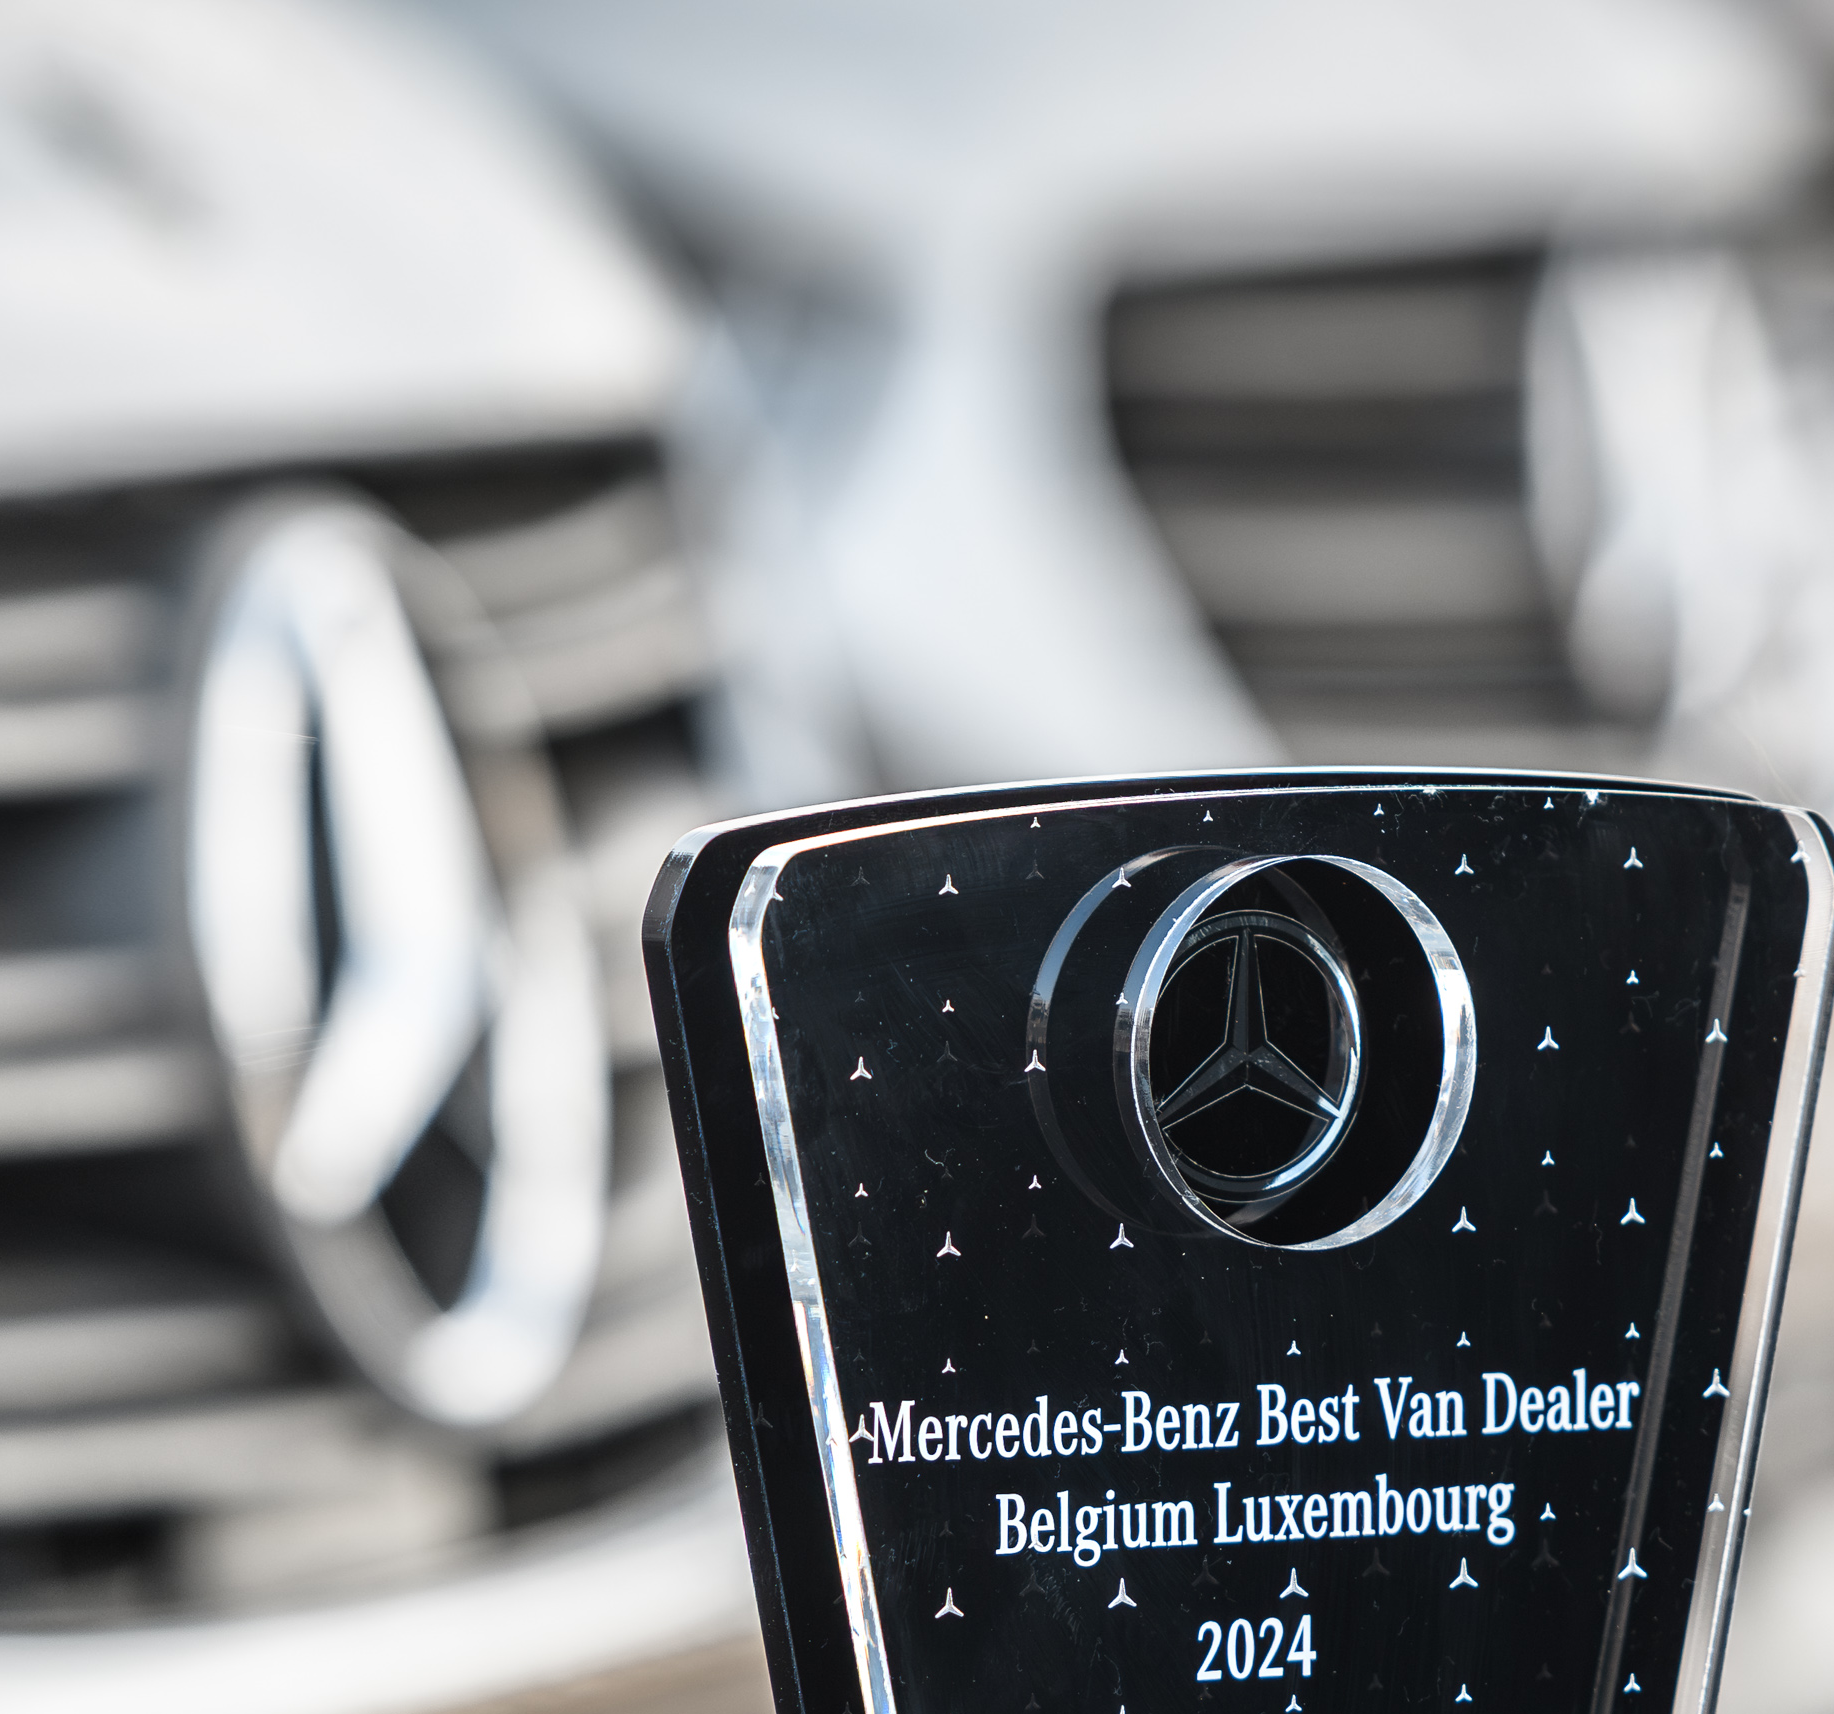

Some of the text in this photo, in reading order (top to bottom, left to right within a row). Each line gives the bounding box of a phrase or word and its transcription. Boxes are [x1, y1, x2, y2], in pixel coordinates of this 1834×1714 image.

[868, 1368, 1640, 1464] Mercedes-Benz Best Van Dealer
[995, 1474, 1515, 1567] Belgium Luxembourg
[1196, 1614, 1317, 1681] 2024
